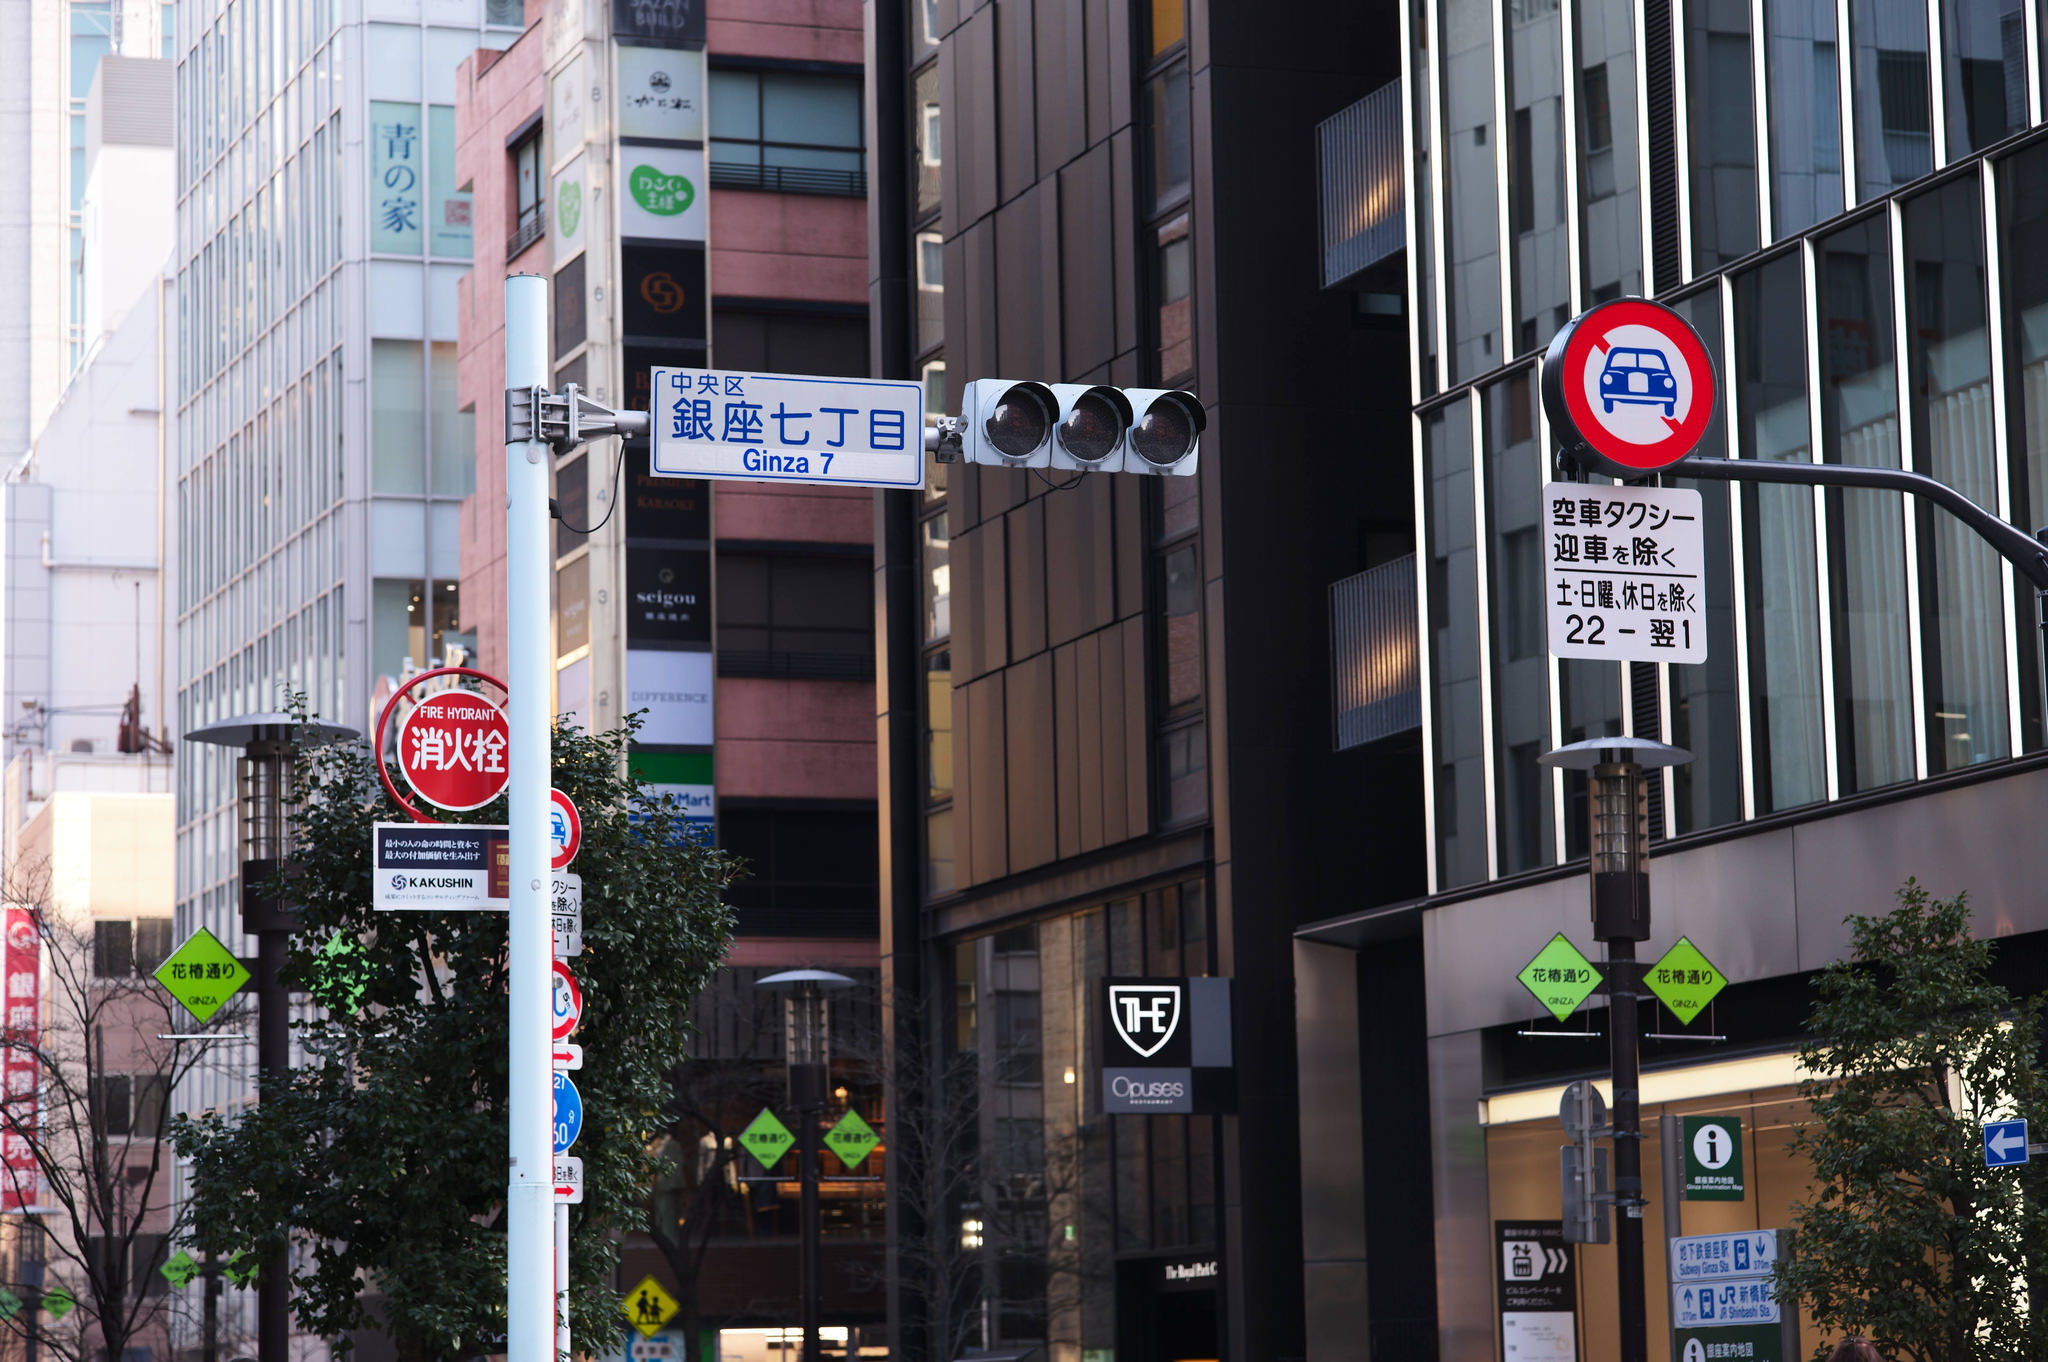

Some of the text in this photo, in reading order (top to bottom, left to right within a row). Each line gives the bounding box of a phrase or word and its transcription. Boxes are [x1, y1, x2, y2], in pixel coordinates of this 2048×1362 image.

[382, 123, 417, 233] 青の家
[671, 372, 744, 397] 中央区
[671, 397, 905, 451] 銀座七丁目
[743, 448, 834, 474] Ginza 7
[1552, 497, 1695, 531] 空車タクシー
[1553, 533, 1676, 568] 迎車を除く
[420, 705, 496, 721] FIRE HYDRANT
[411, 726, 507, 773] 消火栓
[409, 878, 473, 888] KAKUSHIN
[172, 963, 235, 980] 花椿通り
[1532, 968, 1590, 984] 花椿通り
[1657, 969, 1713, 985] 花椿通り
[188, 996, 218, 1006] GINZA
[1548, 996, 1575, 1006] GINZA
[1672, 1000, 1699, 1009] GINZA
[1119, 997, 1171, 1033] THE
[1719, 1286, 1736, 1305] JR
